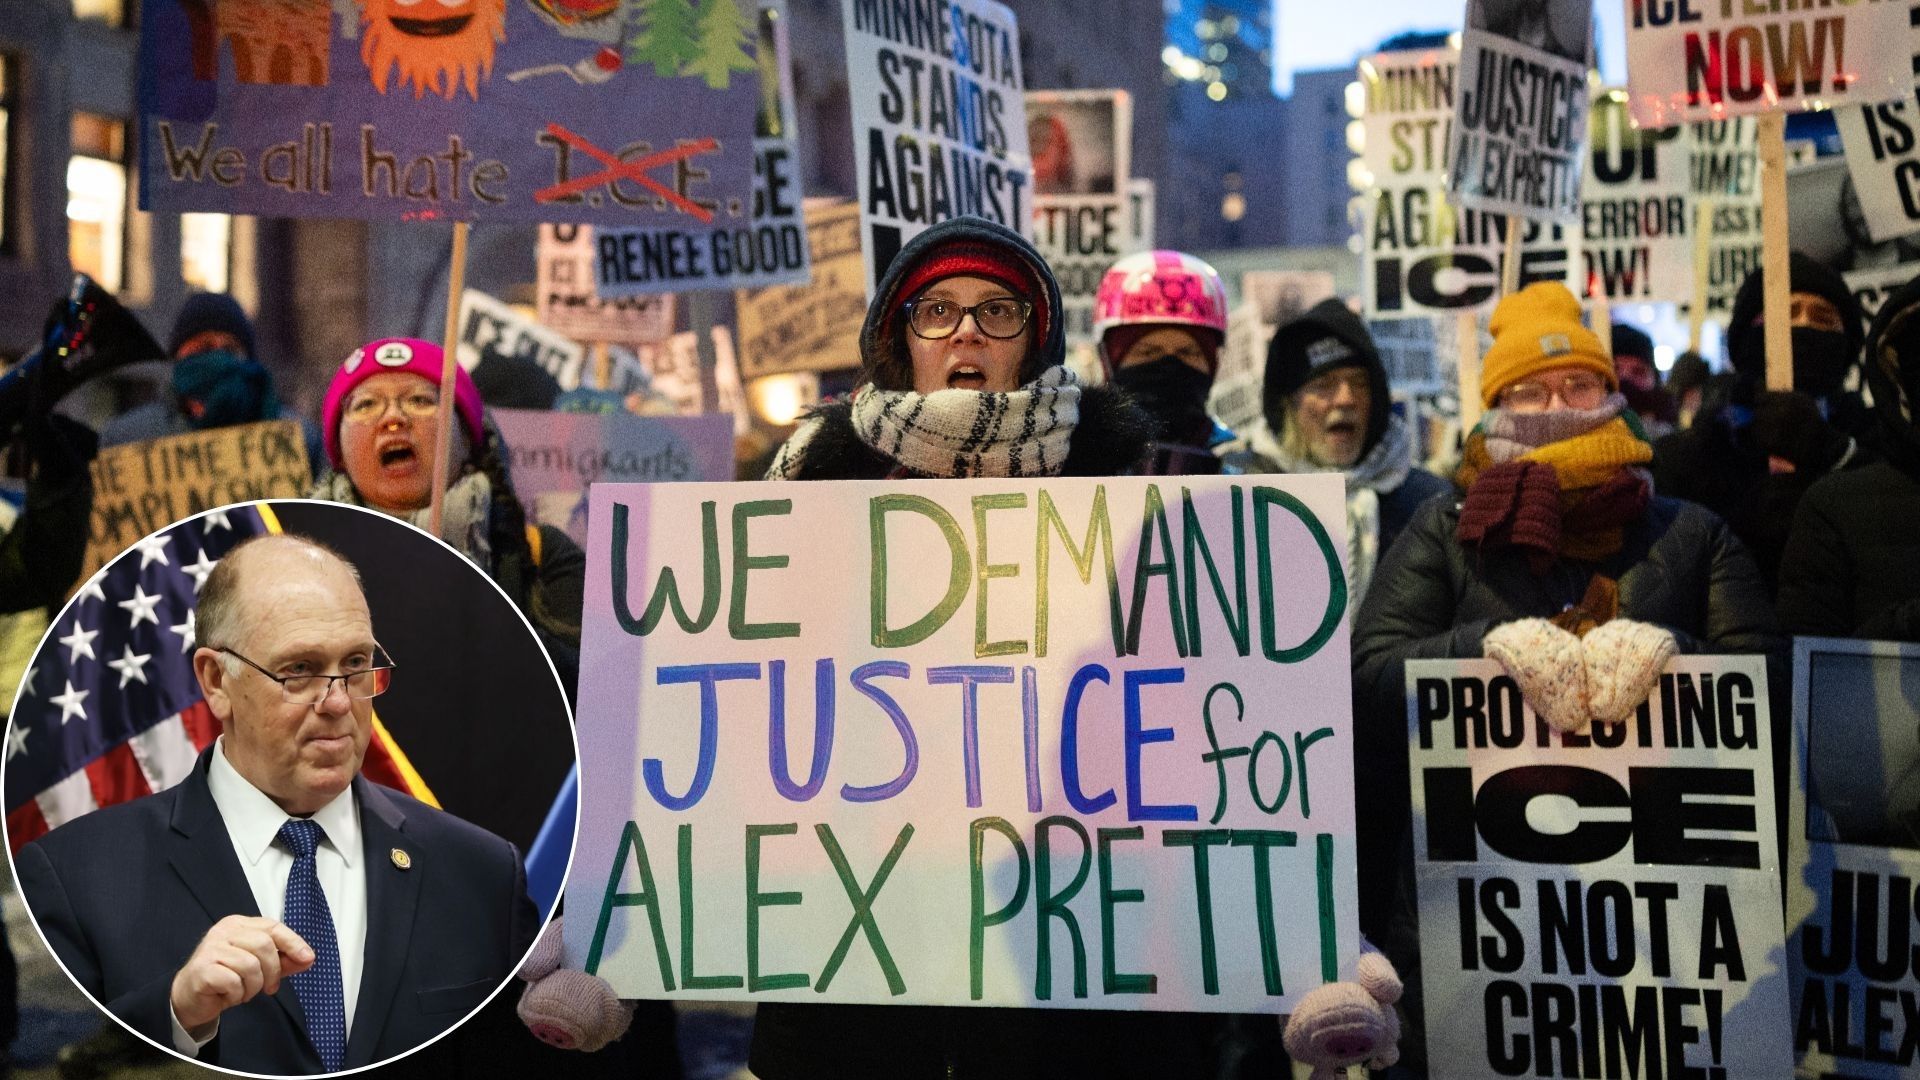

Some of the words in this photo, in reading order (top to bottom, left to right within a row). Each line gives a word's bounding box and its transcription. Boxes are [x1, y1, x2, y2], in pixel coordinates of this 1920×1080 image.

[877, 47, 1008, 160] STANDS
[1461, 47, 1585, 151] JUSTICE
[1684, 16, 1848, 106] NOW!
[159, 121, 247, 188] We
[260, 121, 334, 194] all
[360, 123, 509, 204] hate
[598, 229, 707, 285] RENEE
[711, 224, 802, 277] GOOD
[140, 437, 227, 486] TIME
[611, 498, 801, 641] WE
[870, 484, 1349, 664] DEMAND
[642, 657, 1198, 822] JUSTICE
[1202, 682, 1334, 825] for
[1422, 764, 1762, 870] ICE
[584, 820, 915, 996] ALEX
[969, 815, 1338, 1001] PRETTI
[1457, 876, 1526, 975] IS
[1536, 878, 1680, 979] NOT
[1698, 884, 1748, 982] A
[1484, 979, 1728, 1080] CRIME!
